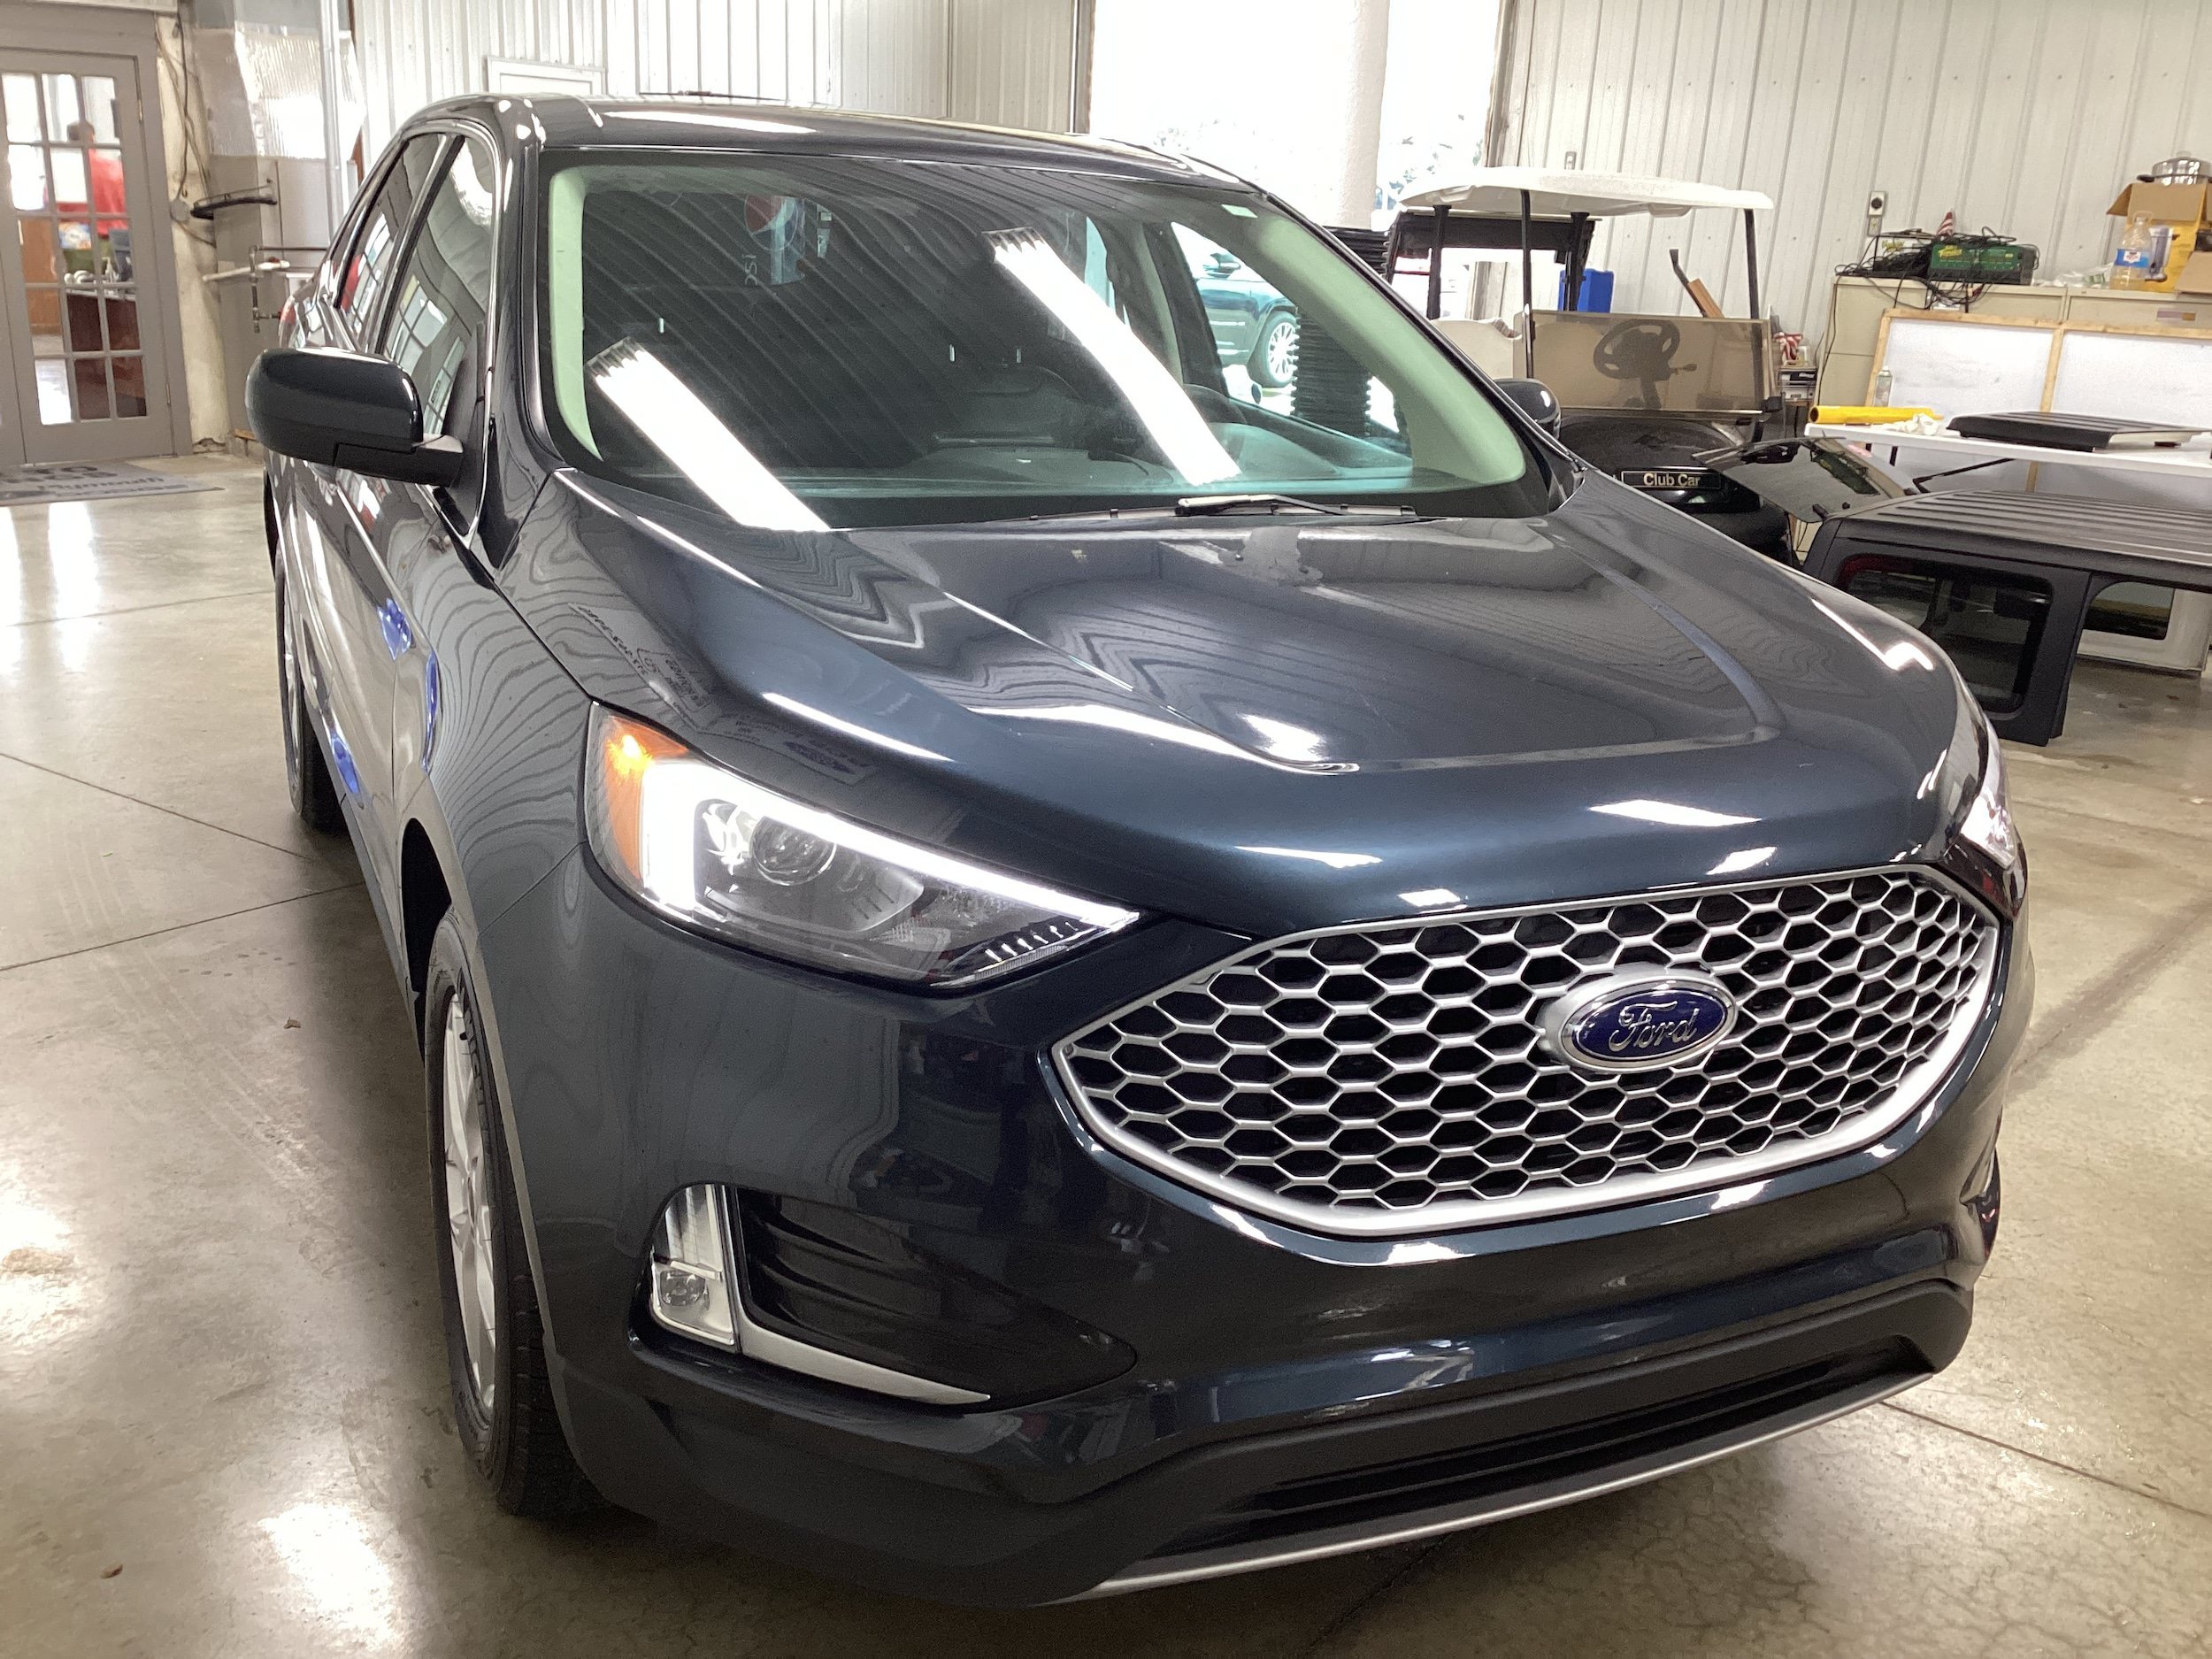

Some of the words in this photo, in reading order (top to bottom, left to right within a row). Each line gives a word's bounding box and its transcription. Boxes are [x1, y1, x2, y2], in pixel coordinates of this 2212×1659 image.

[1643, 472, 1675, 487] Club
[1678, 473, 1701, 487] Car
[1609, 1000, 1700, 1052] Ford
